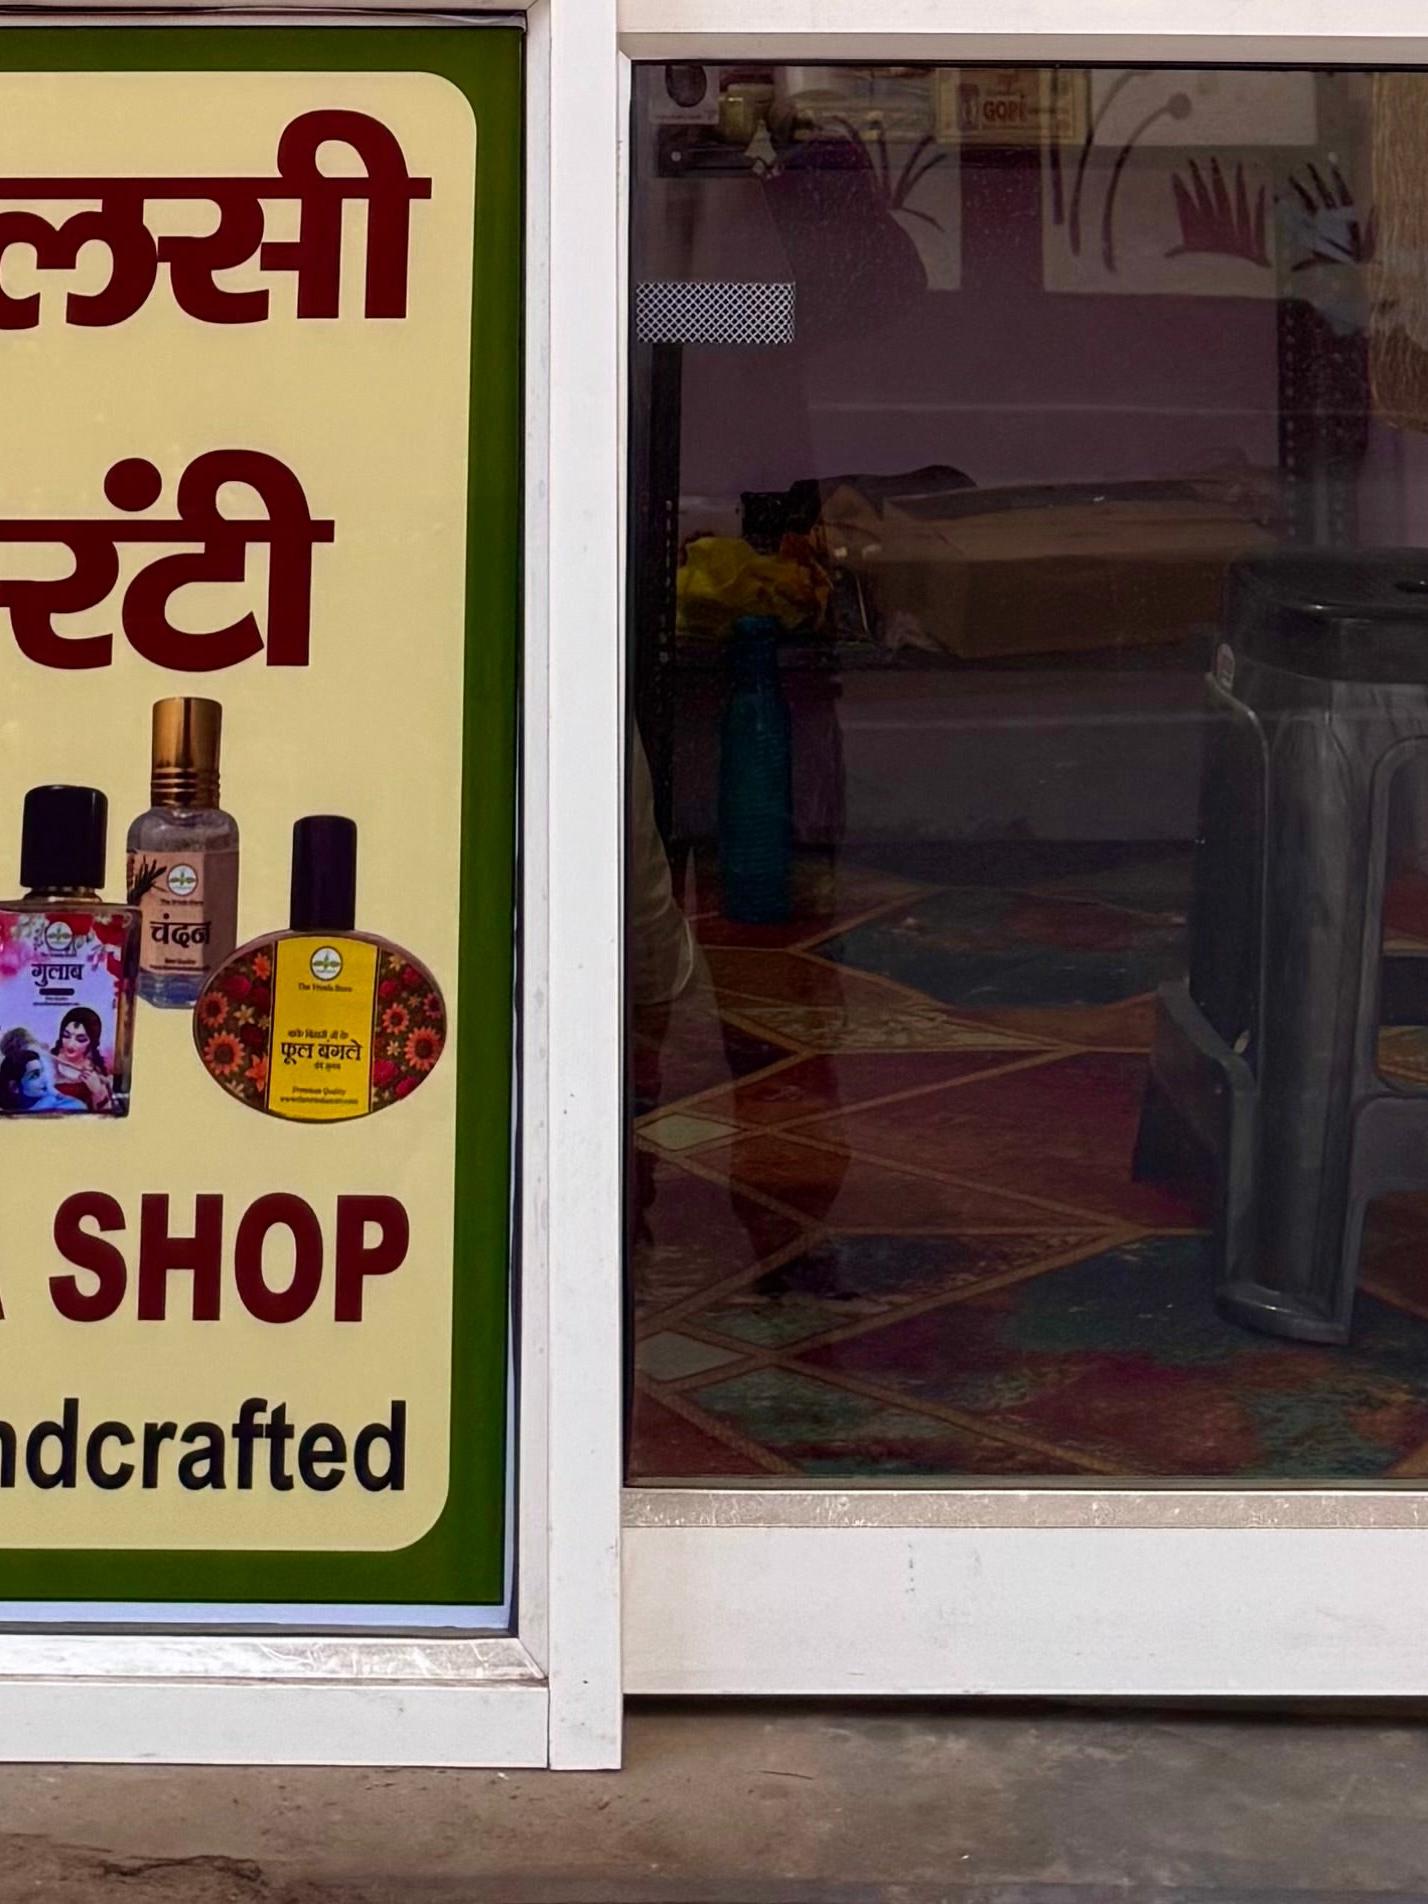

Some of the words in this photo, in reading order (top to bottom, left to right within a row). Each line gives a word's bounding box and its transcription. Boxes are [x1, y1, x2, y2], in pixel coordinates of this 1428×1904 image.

[150, 913, 212, 947] चंदन
[31, 963, 85, 987] गुलाब
[280, 1041, 315, 1065] फूल
[317, 1039, 363, 1061] बंगले
[49, 1191, 409, 1323] SHOP
